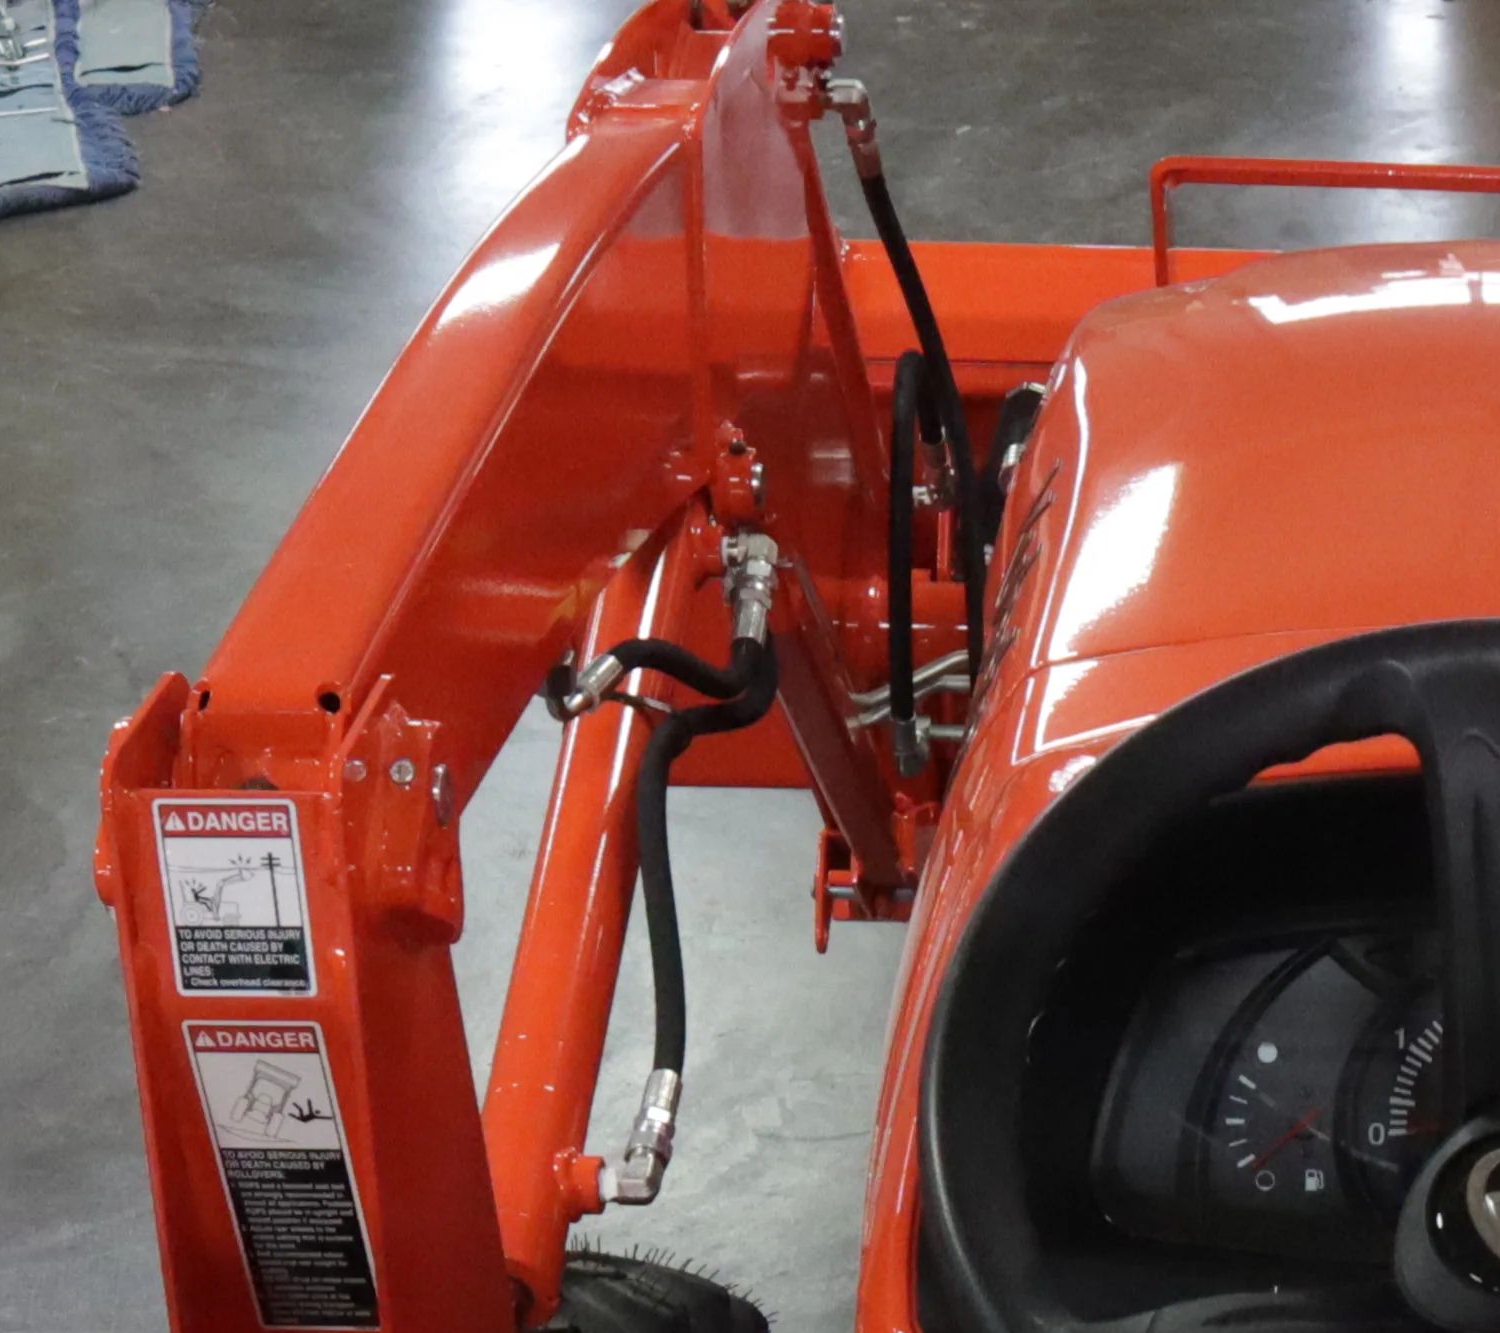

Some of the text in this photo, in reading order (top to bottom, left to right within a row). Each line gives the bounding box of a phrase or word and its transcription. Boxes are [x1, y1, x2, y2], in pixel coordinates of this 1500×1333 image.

[186, 811, 289, 831] DANGER
[193, 929, 222, 939] AVOID
[223, 929, 265, 939] SERIOUS
[196, 941, 227, 951] DEATH
[229, 941, 268, 951] CAUSED
[269, 941, 284, 950] BY
[181, 953, 300, 964] CONTACT WITH ELECTRIC
[215, 1031, 315, 1048] DANGER
[1396, 1028, 1405, 1048] 1
[1368, 1123, 1386, 1146] 0
